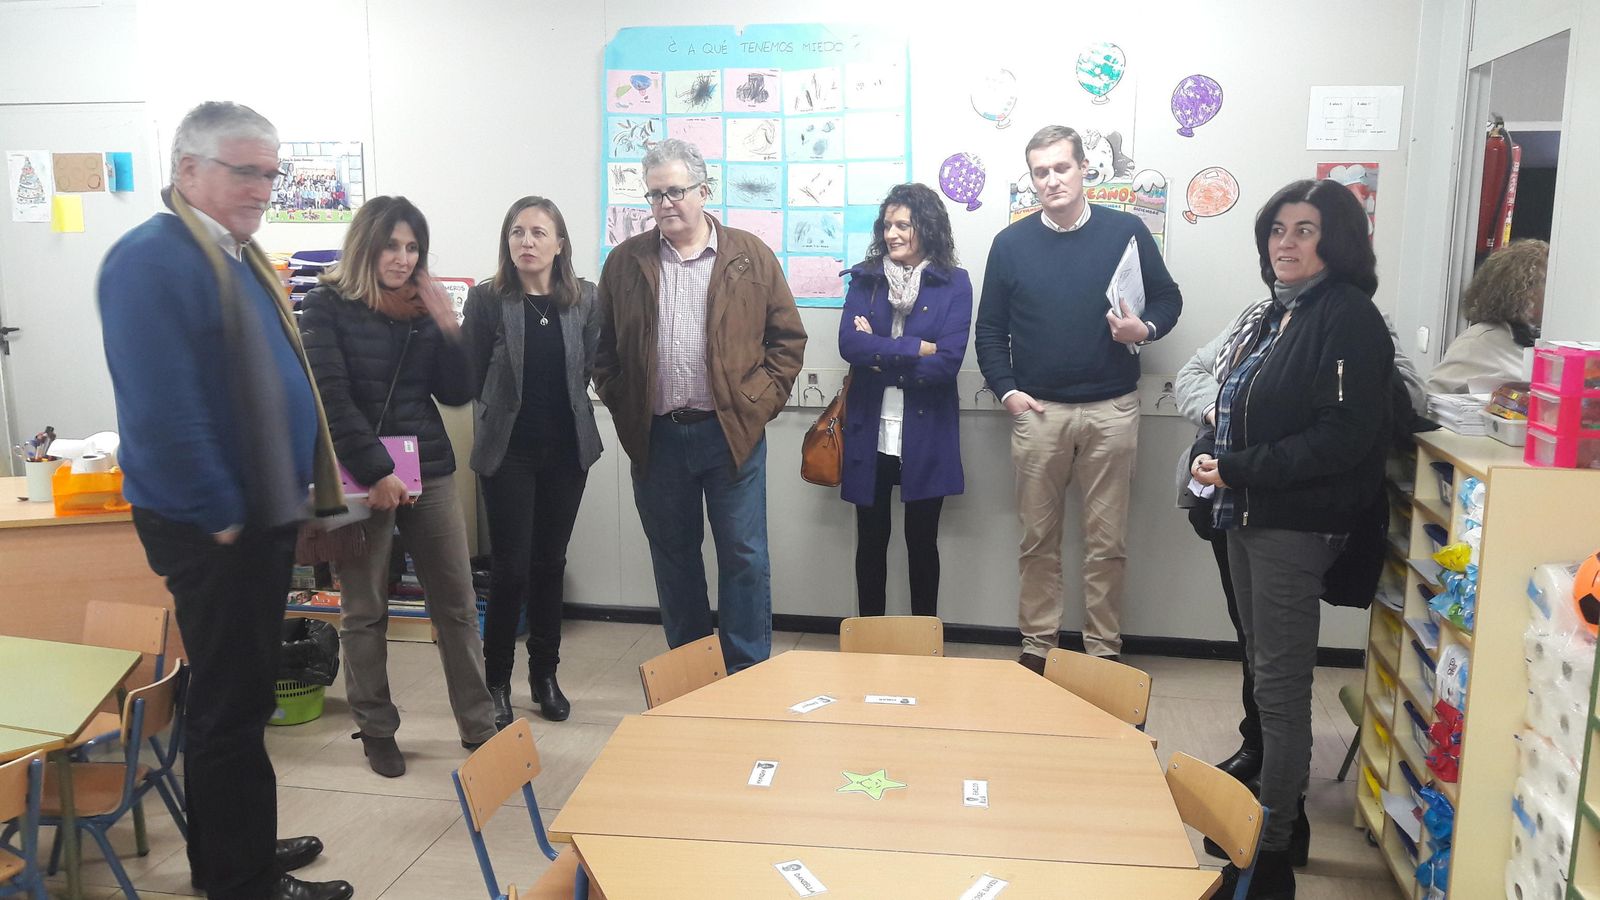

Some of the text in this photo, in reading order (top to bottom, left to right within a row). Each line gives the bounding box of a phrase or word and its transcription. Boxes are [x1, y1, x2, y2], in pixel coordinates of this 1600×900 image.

[687, 42, 697, 56] A
[702, 39, 729, 55] QUÉ
[740, 41, 794, 54] TENEMOS
[803, 41, 844, 53] MIEDO
[1086, 186, 1137, 204] EAÑOS
